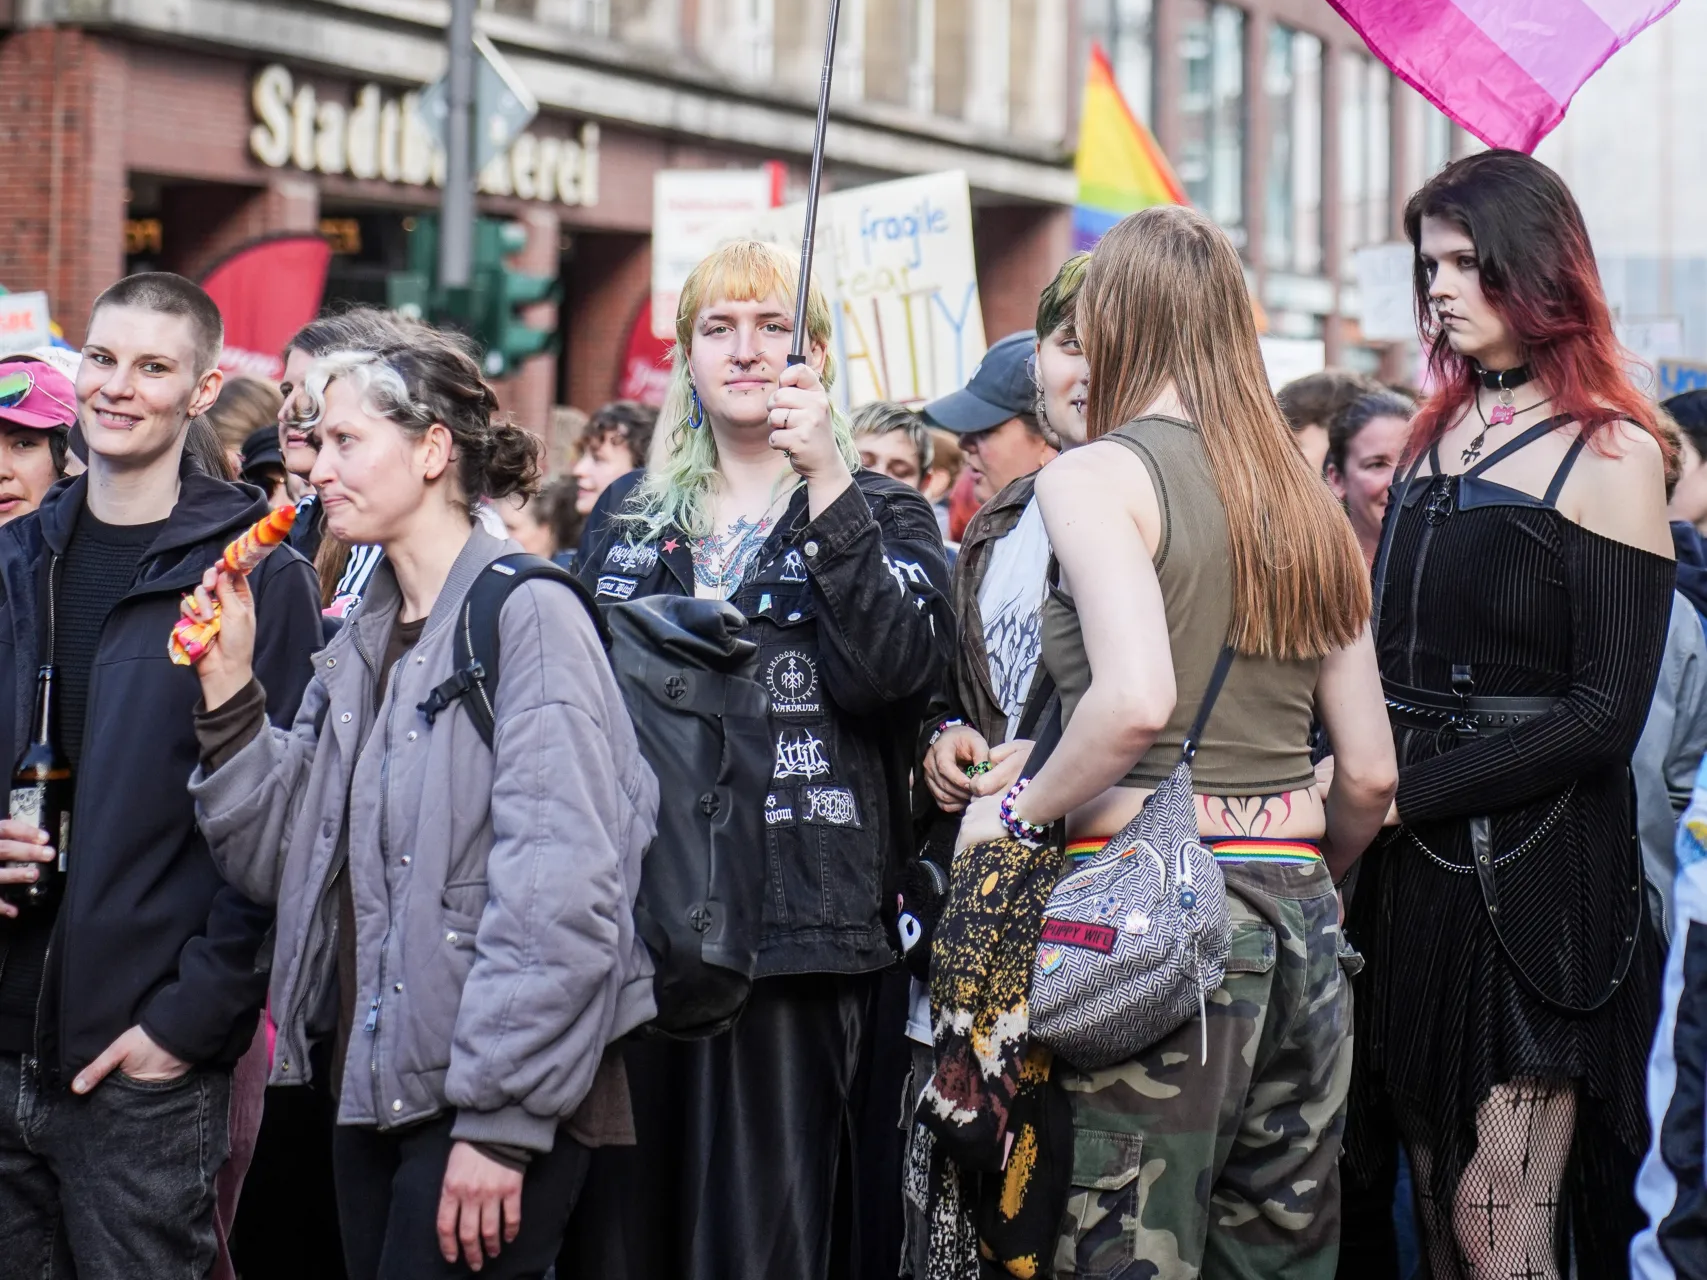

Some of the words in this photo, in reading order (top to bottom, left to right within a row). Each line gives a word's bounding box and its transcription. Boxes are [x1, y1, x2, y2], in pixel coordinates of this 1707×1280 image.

[250, 63, 600, 208] Stadtberei
[861, 198, 949, 269] fragile
[1044, 923, 1080, 939] PUPPY
[1084, 928, 1112, 946] WIFE
